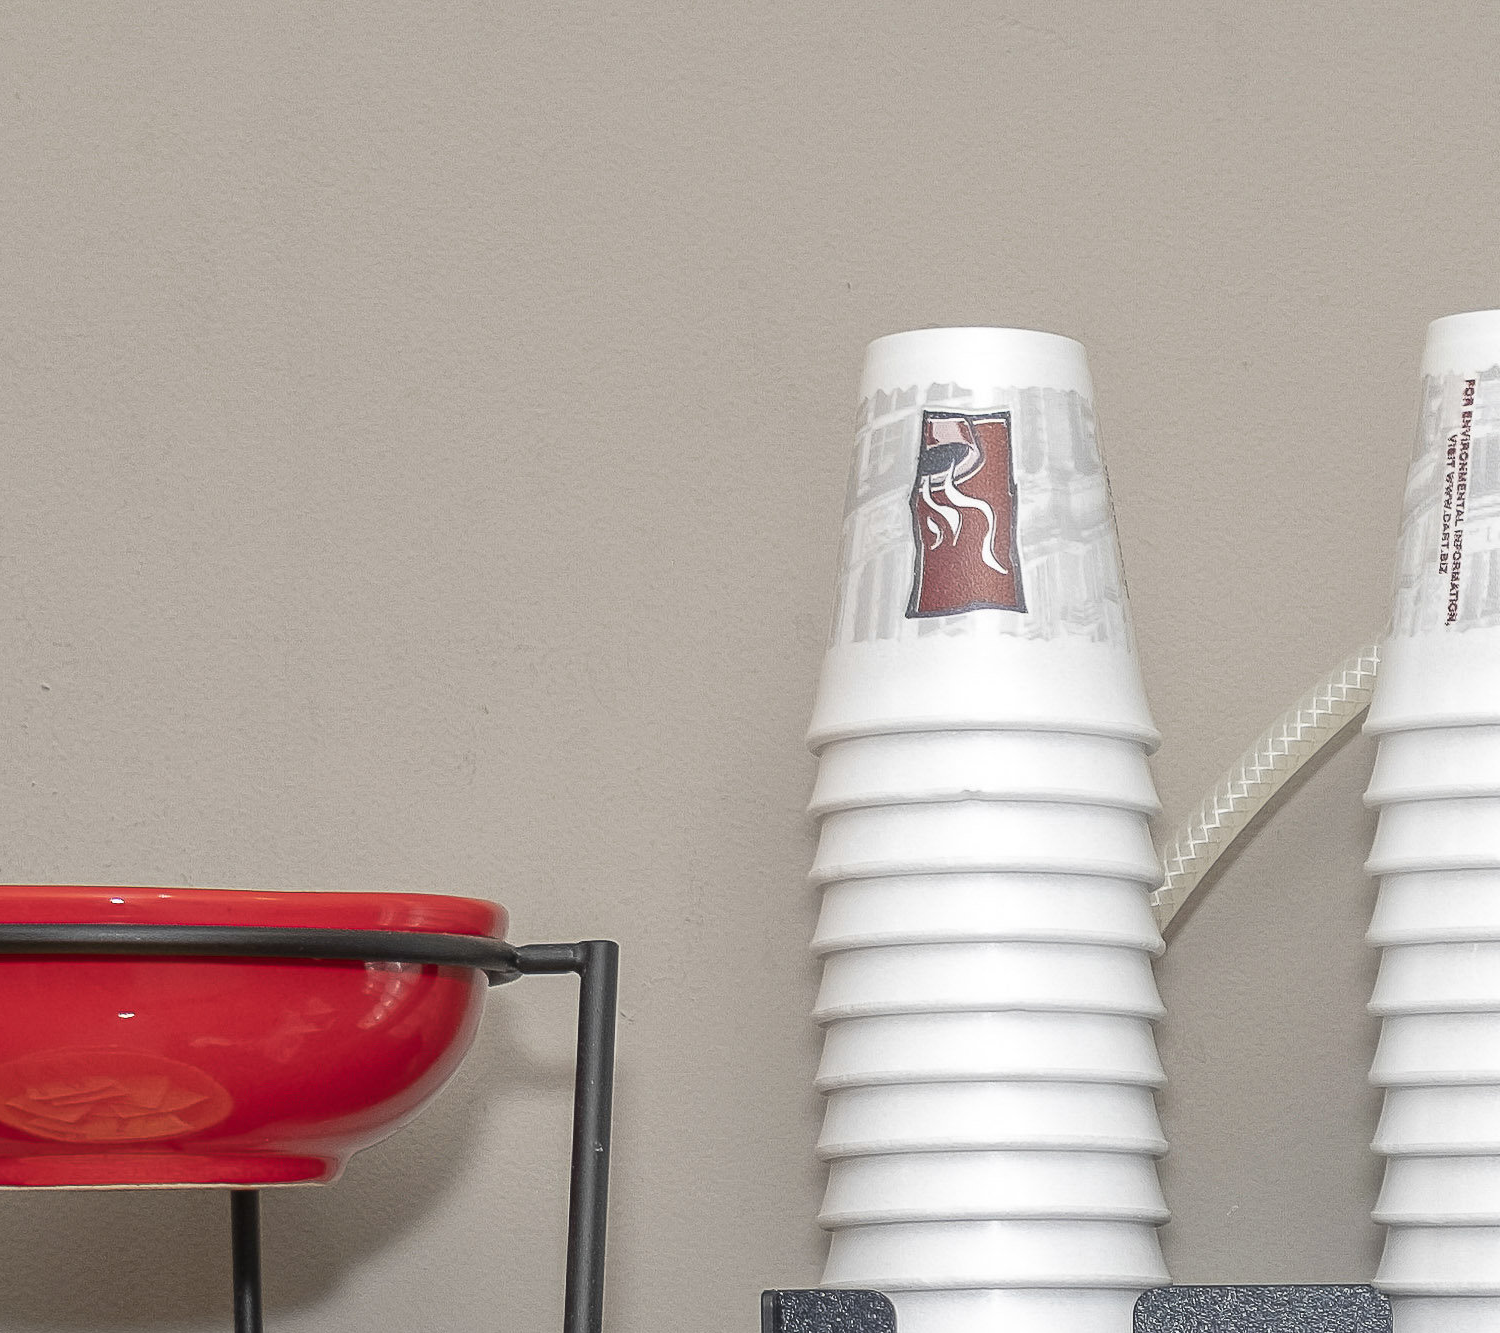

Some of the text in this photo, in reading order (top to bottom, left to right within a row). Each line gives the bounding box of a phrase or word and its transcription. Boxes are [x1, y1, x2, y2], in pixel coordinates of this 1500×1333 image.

[1462, 379, 1476, 407] FOR
[1446, 434, 1458, 468] VISIT
[1454, 410, 1473, 527] ENVIRONMENTAL
